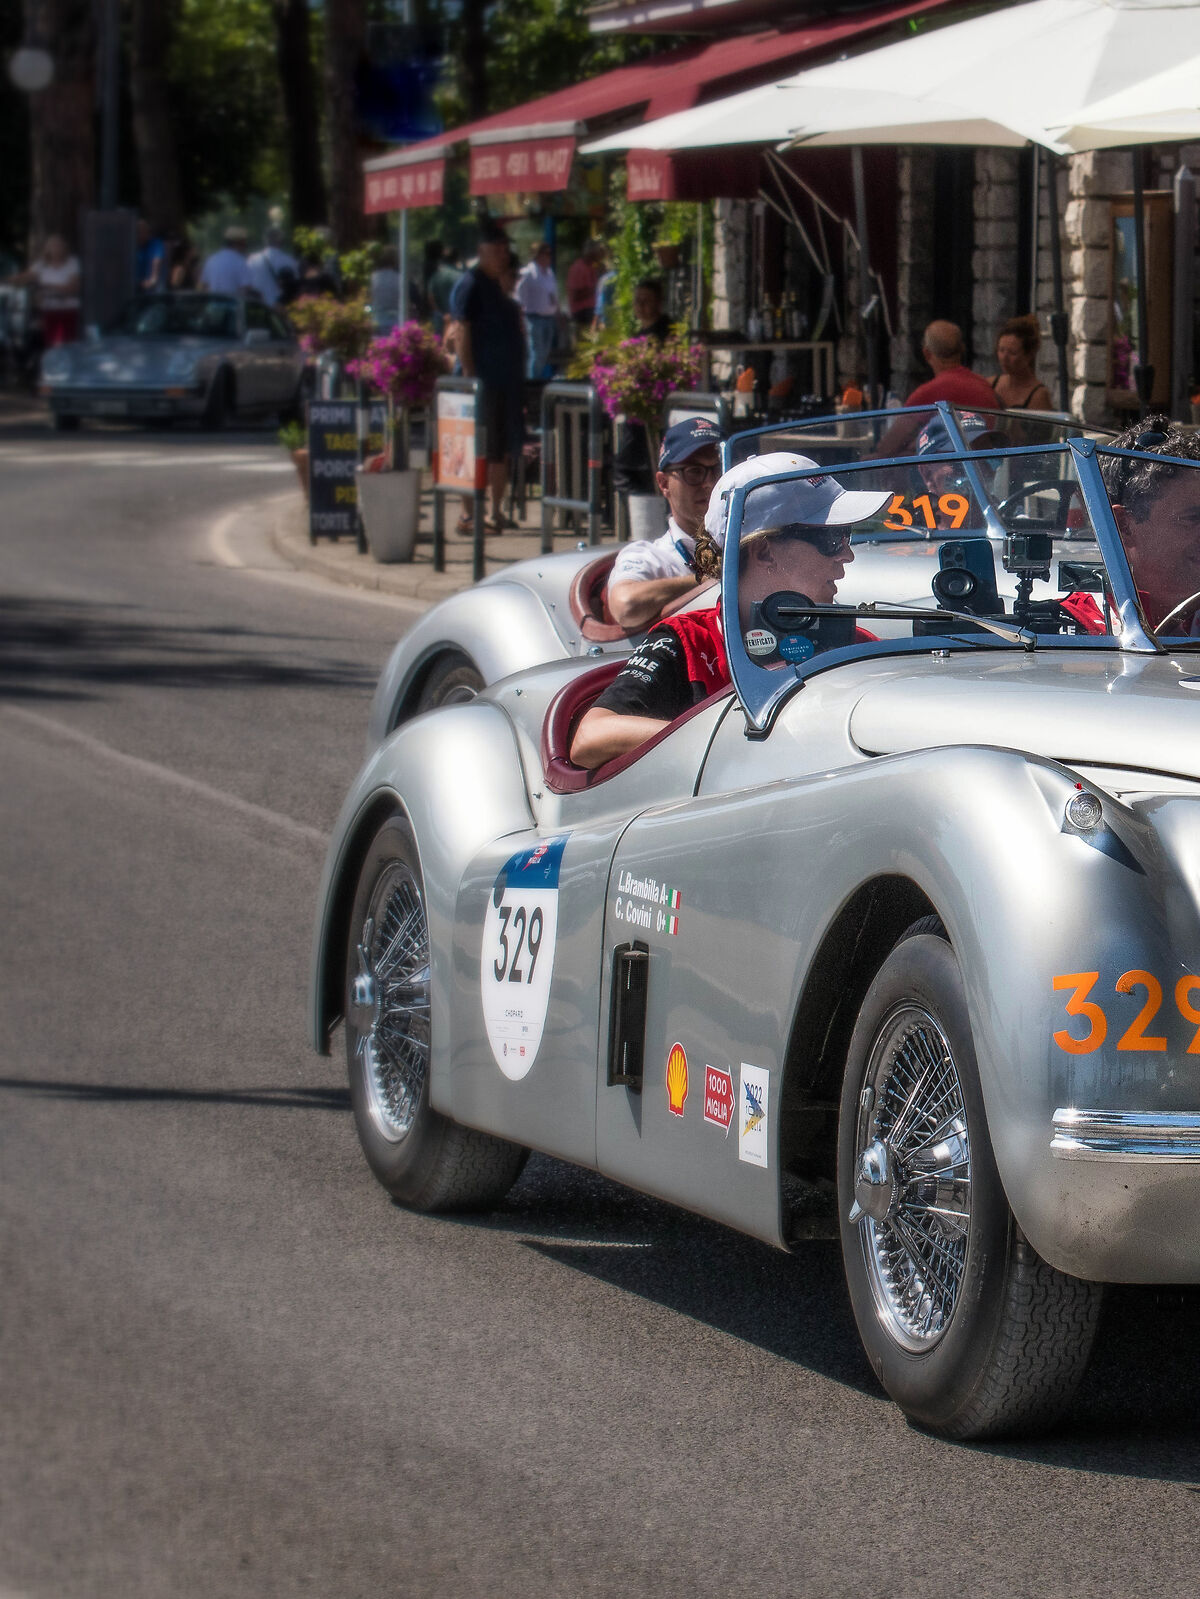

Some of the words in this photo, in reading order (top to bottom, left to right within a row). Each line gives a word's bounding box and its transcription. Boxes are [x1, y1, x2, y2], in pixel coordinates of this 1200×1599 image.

[883, 493, 969, 531] 319
[618, 870, 660, 903] L.Brambilla
[615, 896, 624, 920] C.
[626, 900, 652, 929] Covini
[494, 906, 543, 985] 329
[709, 1073, 727, 1096] 1000
[706, 1097, 728, 1121] MIGLIA
